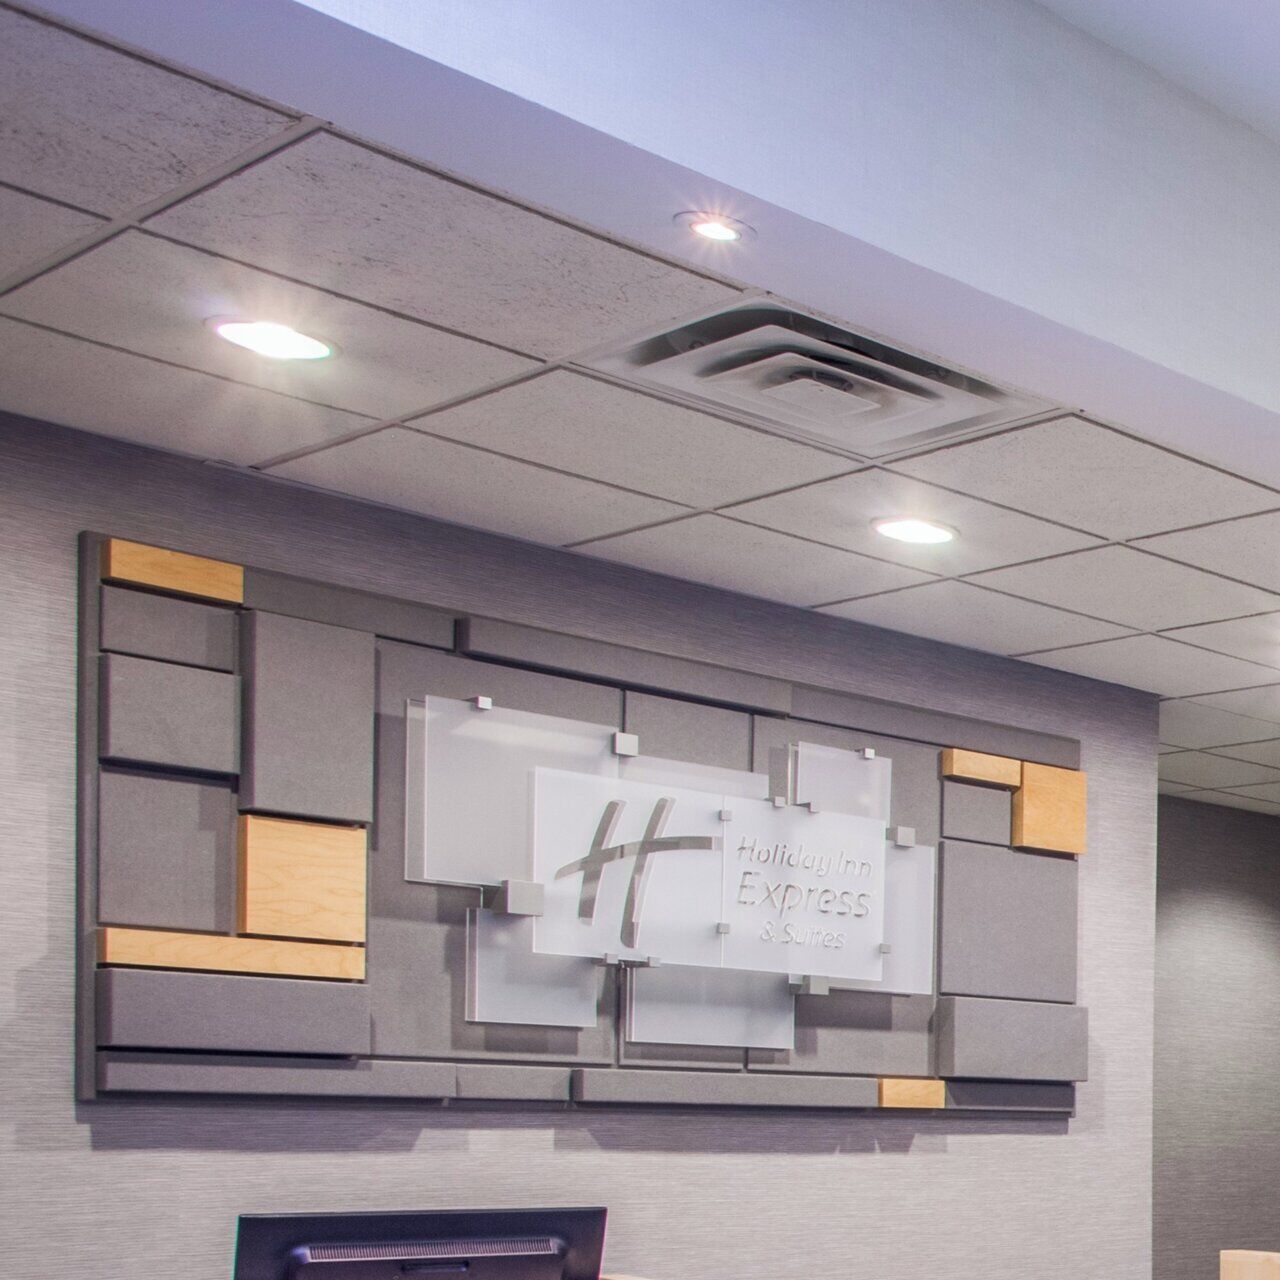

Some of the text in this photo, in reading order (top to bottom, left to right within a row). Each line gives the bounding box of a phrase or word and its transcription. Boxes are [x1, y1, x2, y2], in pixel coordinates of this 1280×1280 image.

[737, 836, 872, 877] Holiday Inn
[737, 871, 871, 919] Express
[760, 920, 845, 948] & Suites
